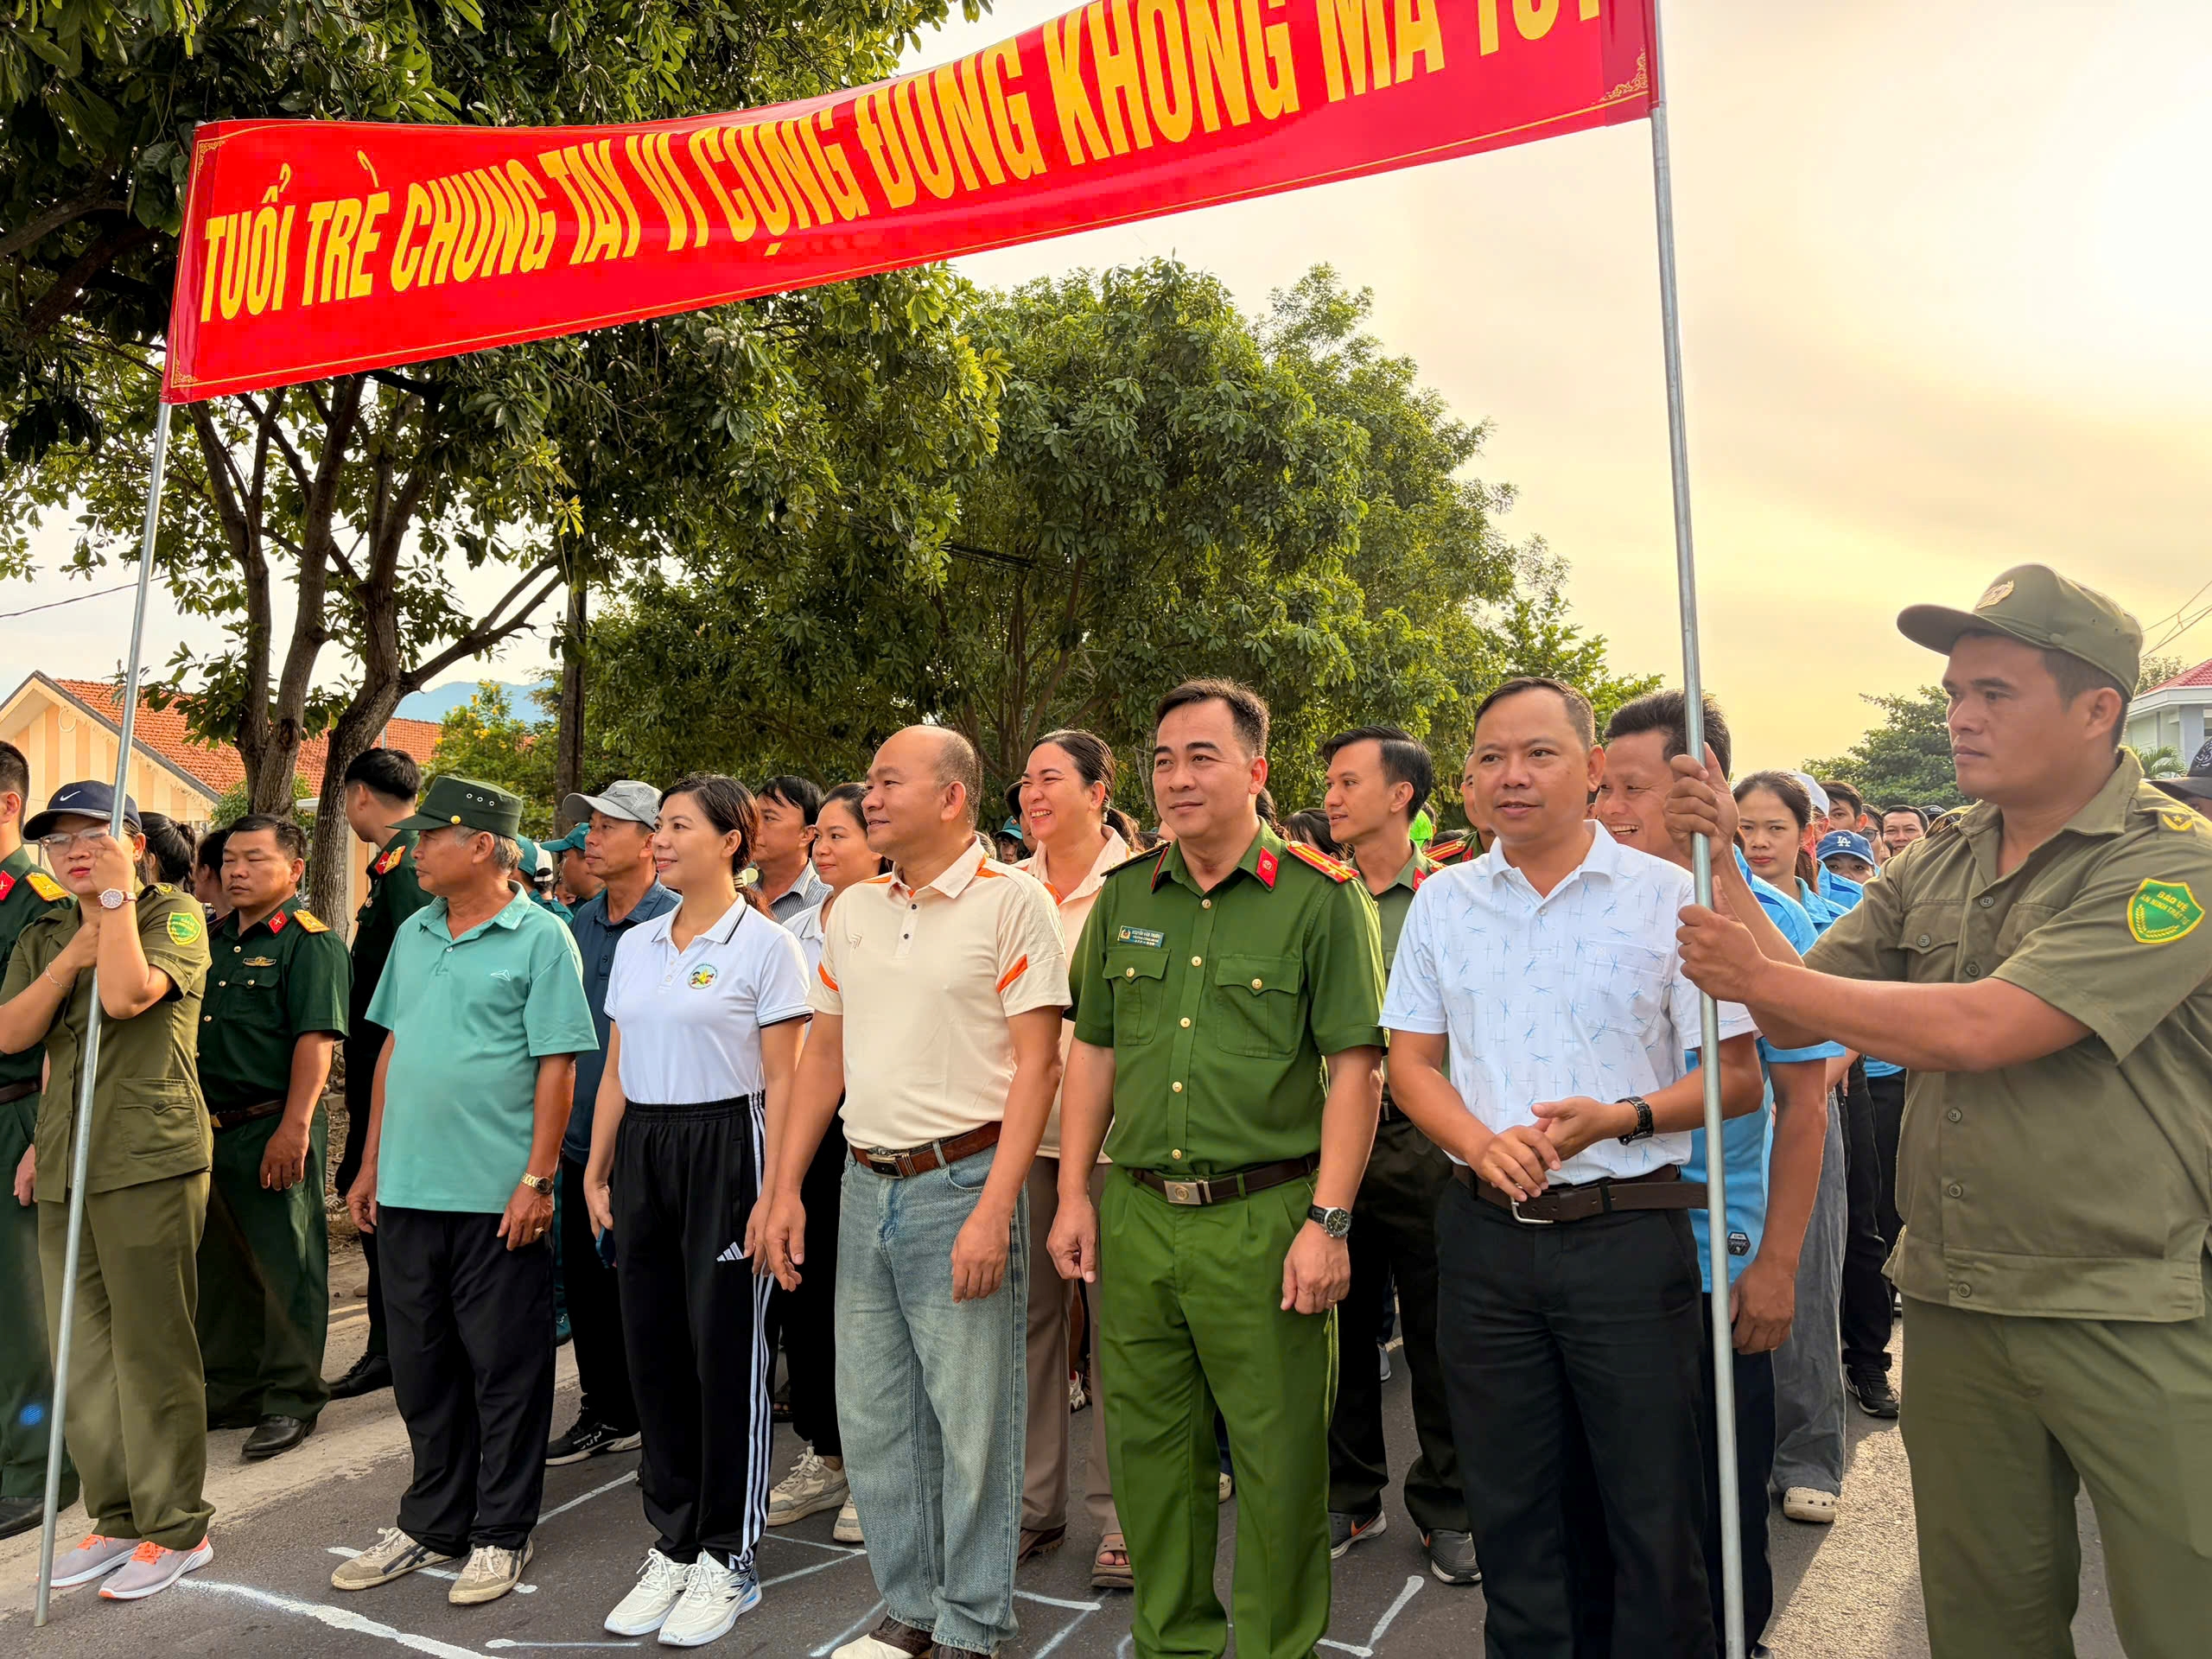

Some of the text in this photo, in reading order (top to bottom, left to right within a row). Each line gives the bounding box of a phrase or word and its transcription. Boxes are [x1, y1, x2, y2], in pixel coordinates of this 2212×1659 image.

[200, 162, 296, 322] TUỔI
[302, 149, 391, 306] TRẺ
[391, 159, 556, 292] CHUNG
[537, 139, 640, 264] TAY
[1836, 836, 1851, 848] LA
